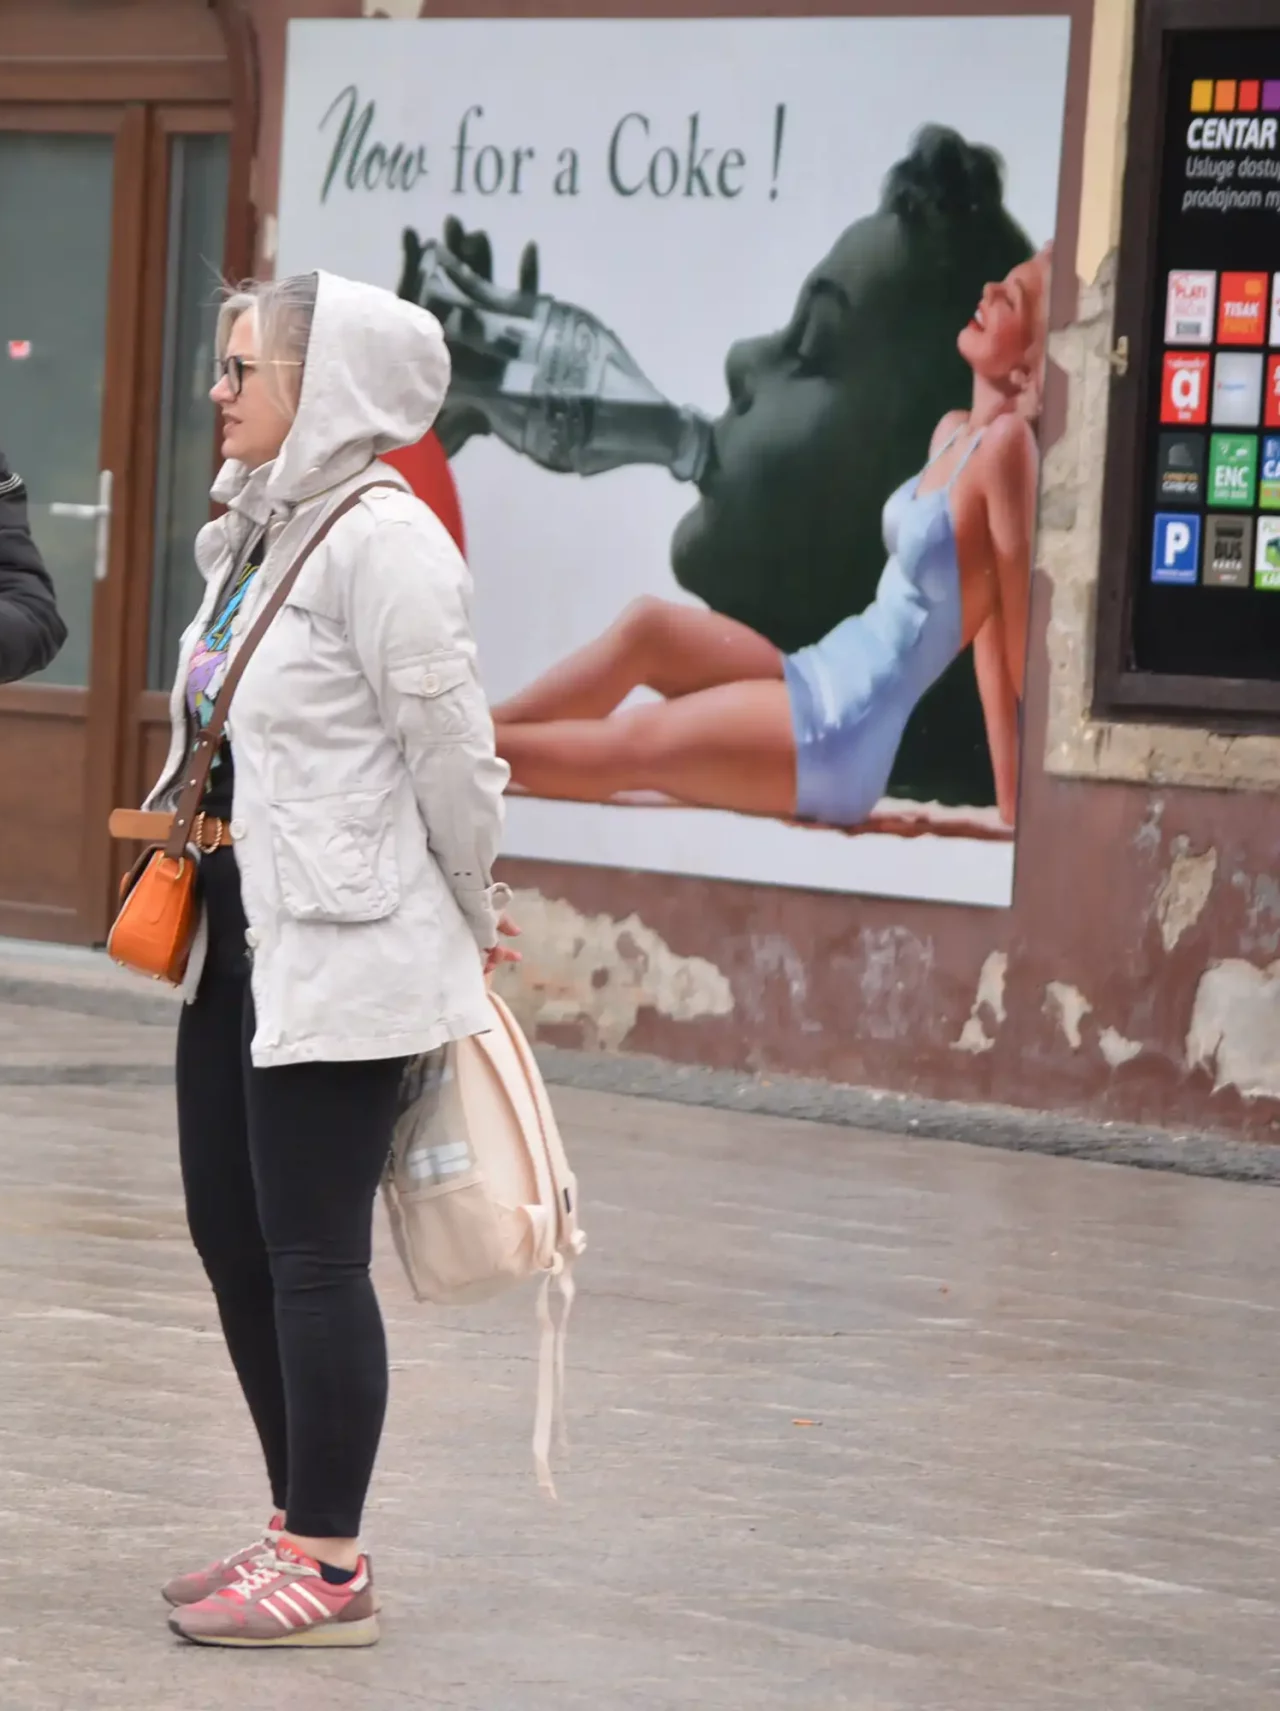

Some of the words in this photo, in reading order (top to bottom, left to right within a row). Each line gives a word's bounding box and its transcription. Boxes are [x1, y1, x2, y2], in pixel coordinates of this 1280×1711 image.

[318, 84, 428, 204] Now
[450, 105, 535, 195] for
[553, 147, 580, 196] a
[608, 112, 747, 198] Coke
[1186, 117, 1278, 151] CENTAR
[1185, 156, 1235, 182] Usluge
[1181, 187, 1262, 212] prodajnom
[1223, 301, 1259, 317] TISAK
[1214, 465, 1249, 488] ENC
[1164, 521, 1190, 567] P
[1214, 541, 1242, 559] BUS
